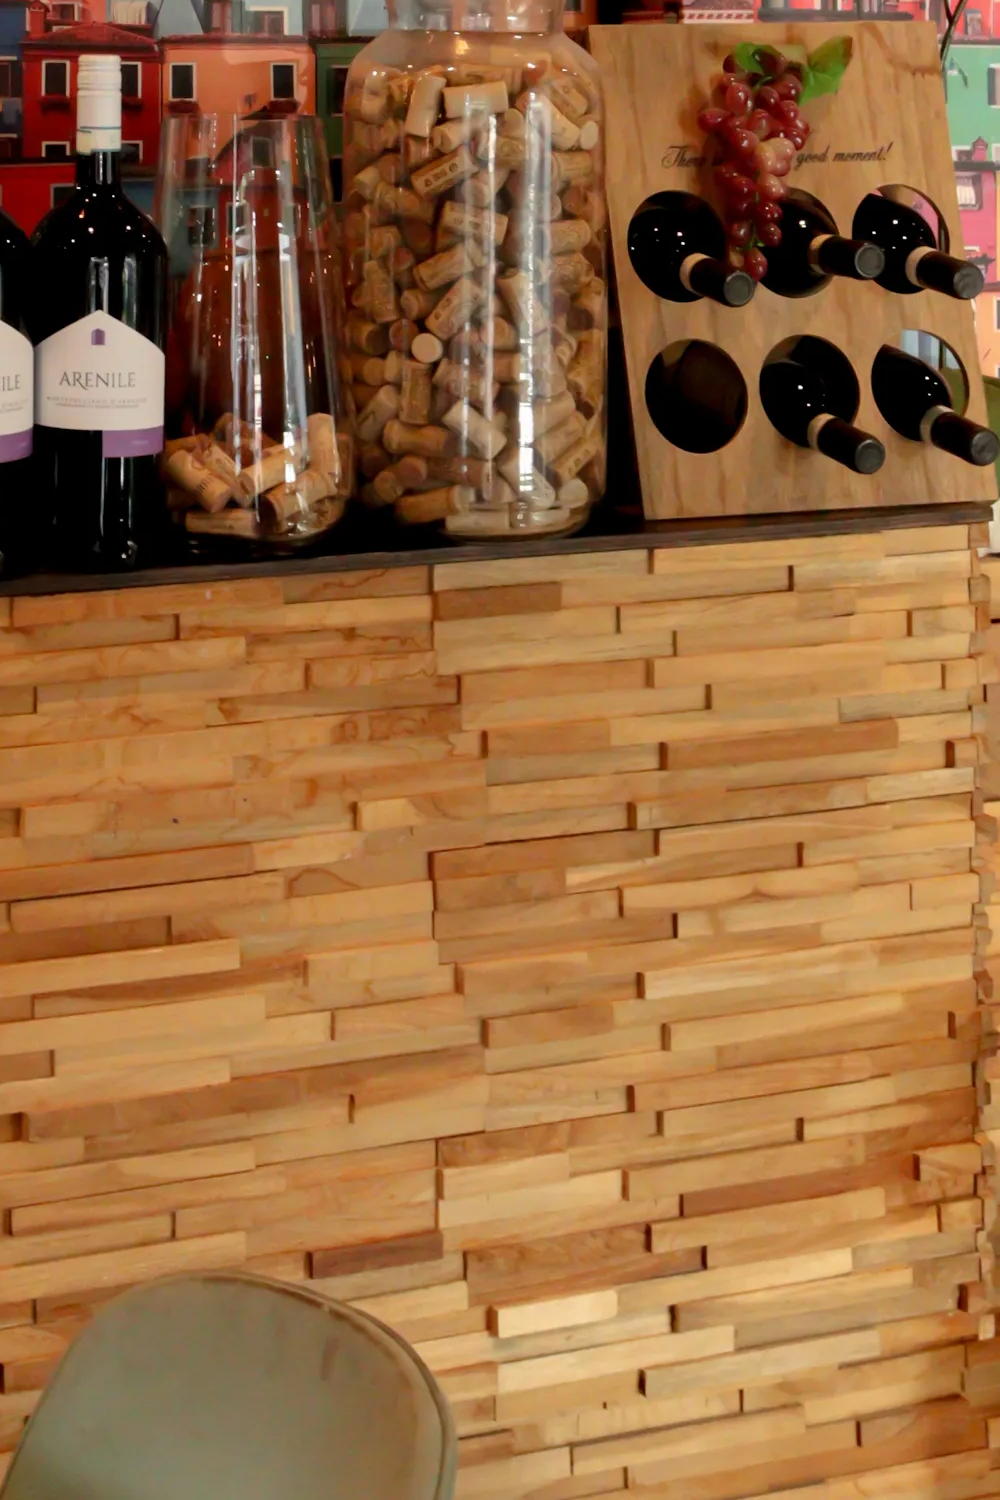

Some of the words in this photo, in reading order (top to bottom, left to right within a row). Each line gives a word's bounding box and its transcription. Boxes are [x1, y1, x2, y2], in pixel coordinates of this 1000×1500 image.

[793, 145, 830, 171] good
[832, 141, 893, 163] moment!
[58, 371, 137, 391] ARENILE
